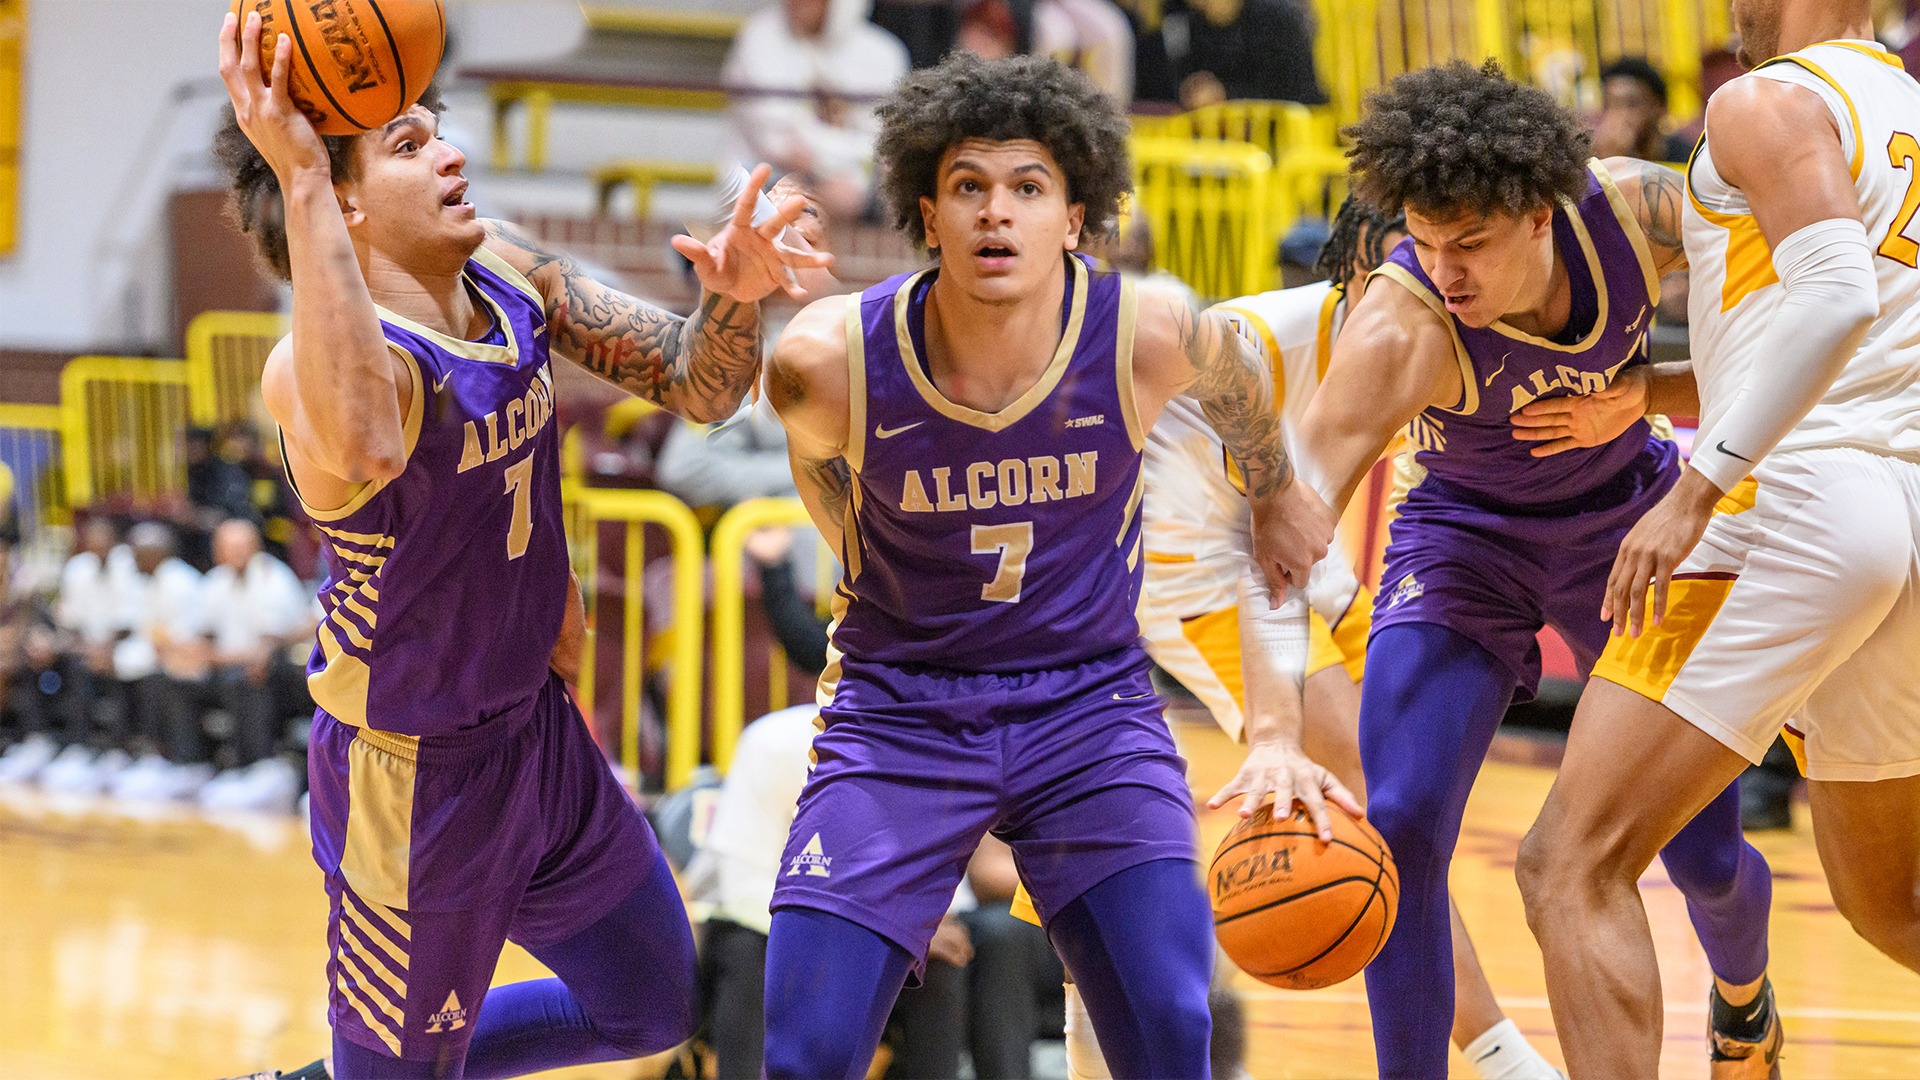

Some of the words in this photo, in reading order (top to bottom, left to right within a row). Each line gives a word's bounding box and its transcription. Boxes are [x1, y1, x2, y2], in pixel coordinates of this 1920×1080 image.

[1074, 414, 1104, 428] SWAC
[503, 448, 535, 561] 7
[899, 451, 1098, 512] ALCORN
[971, 521, 1034, 603] 7
[1217, 847, 1292, 898] NCAA
